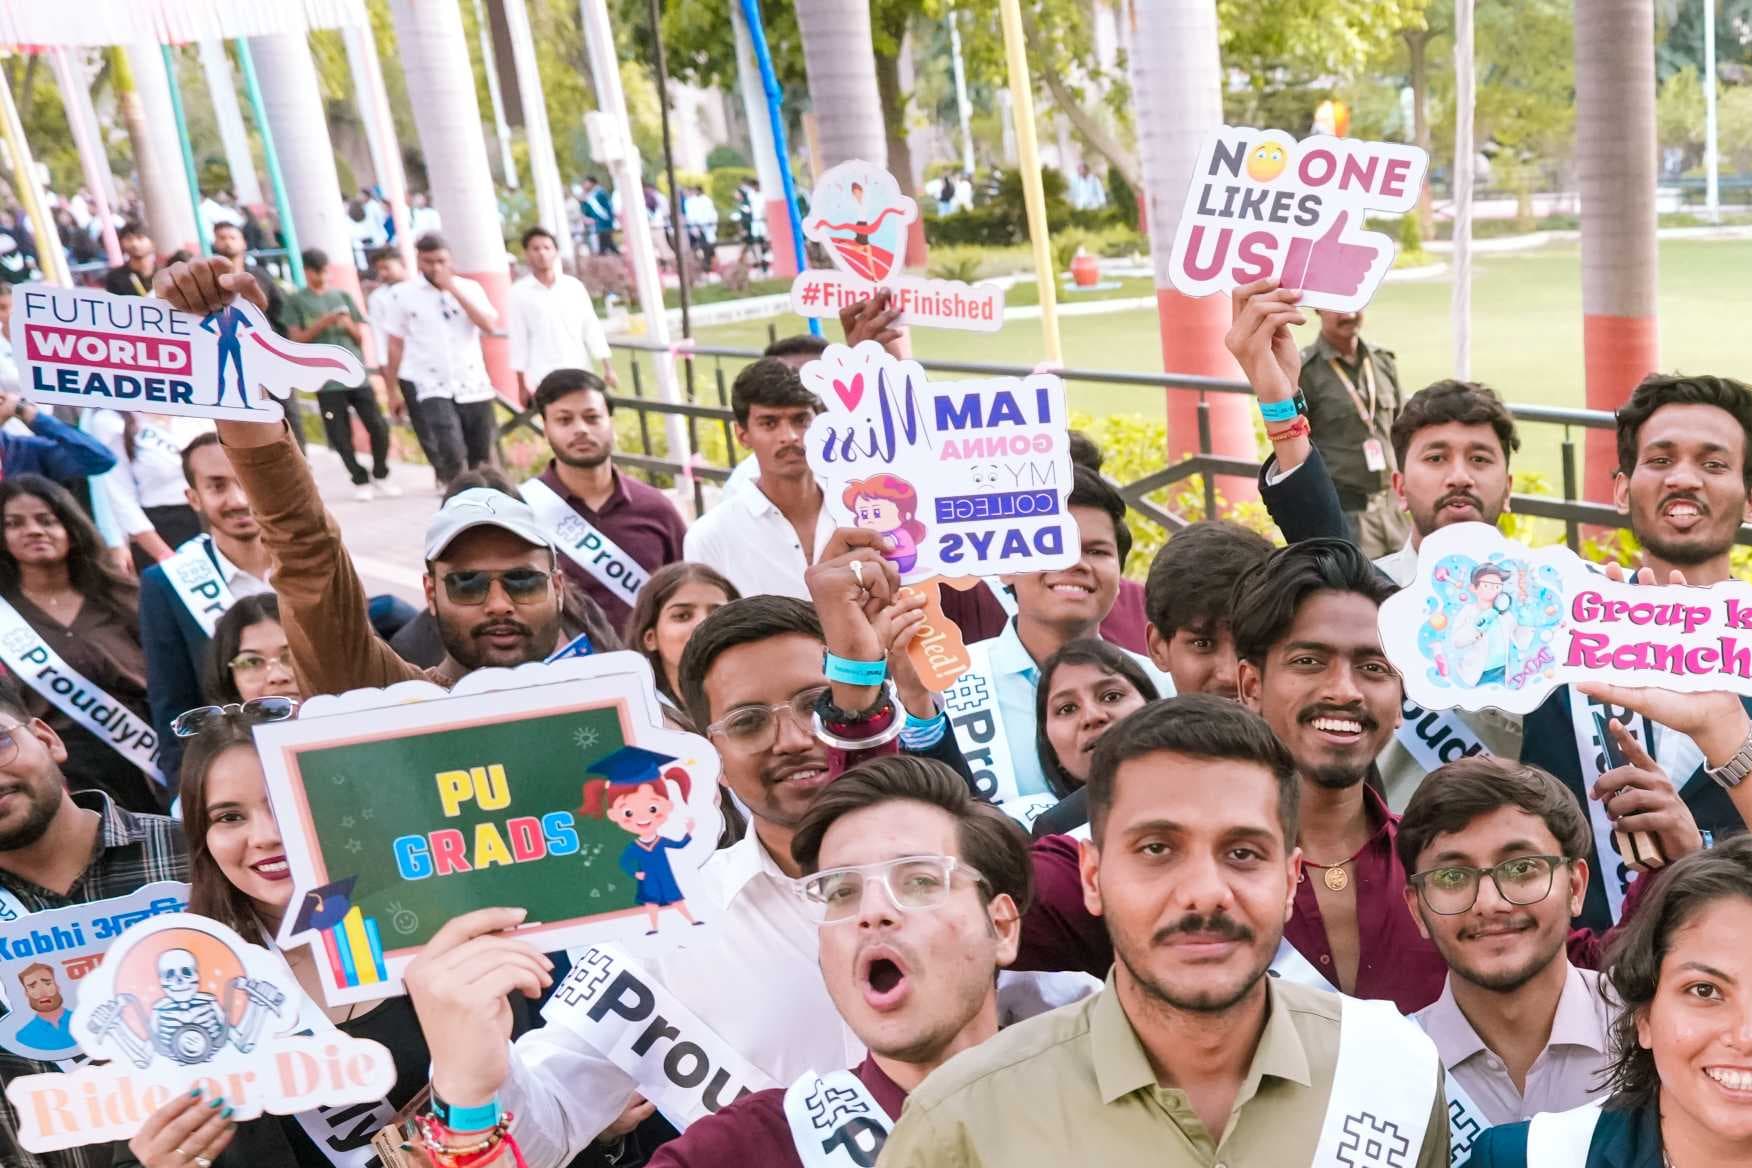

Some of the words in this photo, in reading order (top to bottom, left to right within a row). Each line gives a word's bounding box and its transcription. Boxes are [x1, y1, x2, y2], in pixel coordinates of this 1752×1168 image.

[1298, 149, 1412, 198] ONE
[1197, 183, 1323, 227] LIKES
[1183, 224, 1279, 285] US
[25, 293, 191, 336] FUTURE
[31, 330, 188, 369] WORLD
[32, 366, 194, 404] LEADER
[1571, 591, 1712, 634] Group
[436, 764, 511, 817] PU
[393, 811, 581, 880] GRADS
[29, 1076, 170, 1138] Ride
[273, 1043, 377, 1099] Die
